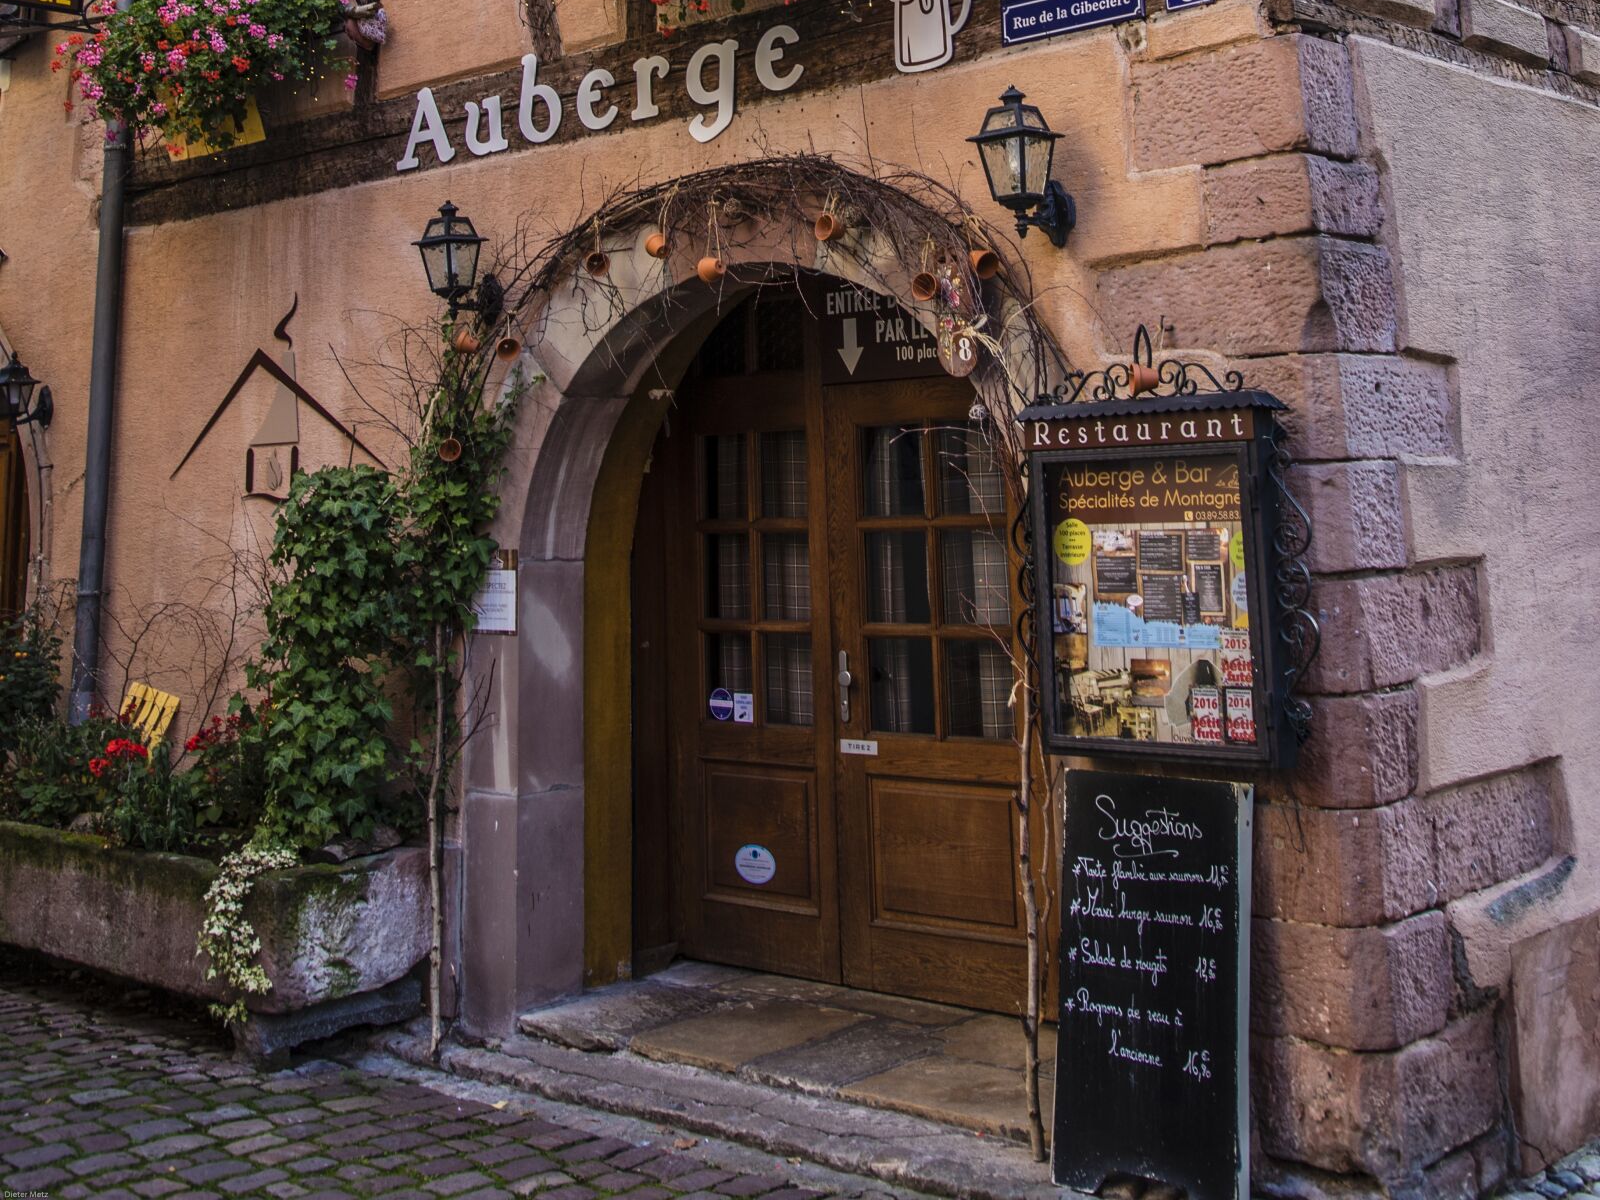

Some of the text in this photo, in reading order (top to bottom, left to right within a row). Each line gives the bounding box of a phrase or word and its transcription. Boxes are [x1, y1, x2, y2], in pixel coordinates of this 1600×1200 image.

[1013, 16, 1036, 30] Rue
[1039, 9, 1053, 23] de
[1056, 6, 1068, 20] la
[396, 25, 804, 171] Auberge
[876, 318, 907, 343] PAR
[896, 344, 937, 362] 100 plac
[1033, 413, 1243, 446] Restaurant
[1059, 464, 1145, 490] Auberge
[1152, 461, 1167, 484] &
[1175, 460, 1212, 484] Bar
[1059, 489, 1241, 512] Spécialités de Montagne
[1225, 639, 1247, 649] 2015
[1194, 697, 1218, 709] 2016
[1228, 697, 1250, 709] 2014
[1095, 794, 1203, 855] Suggestions
[1078, 856, 1107, 878] Tarte
[1082, 886, 1114, 918] Maxi
[1118, 891, 1151, 934] burger
[1154, 908, 1193, 926] saumon
[1081, 937, 1116, 968] Salade
[1120, 945, 1132, 969] de
[1076, 987, 1184, 1027] Rognons de veau à
